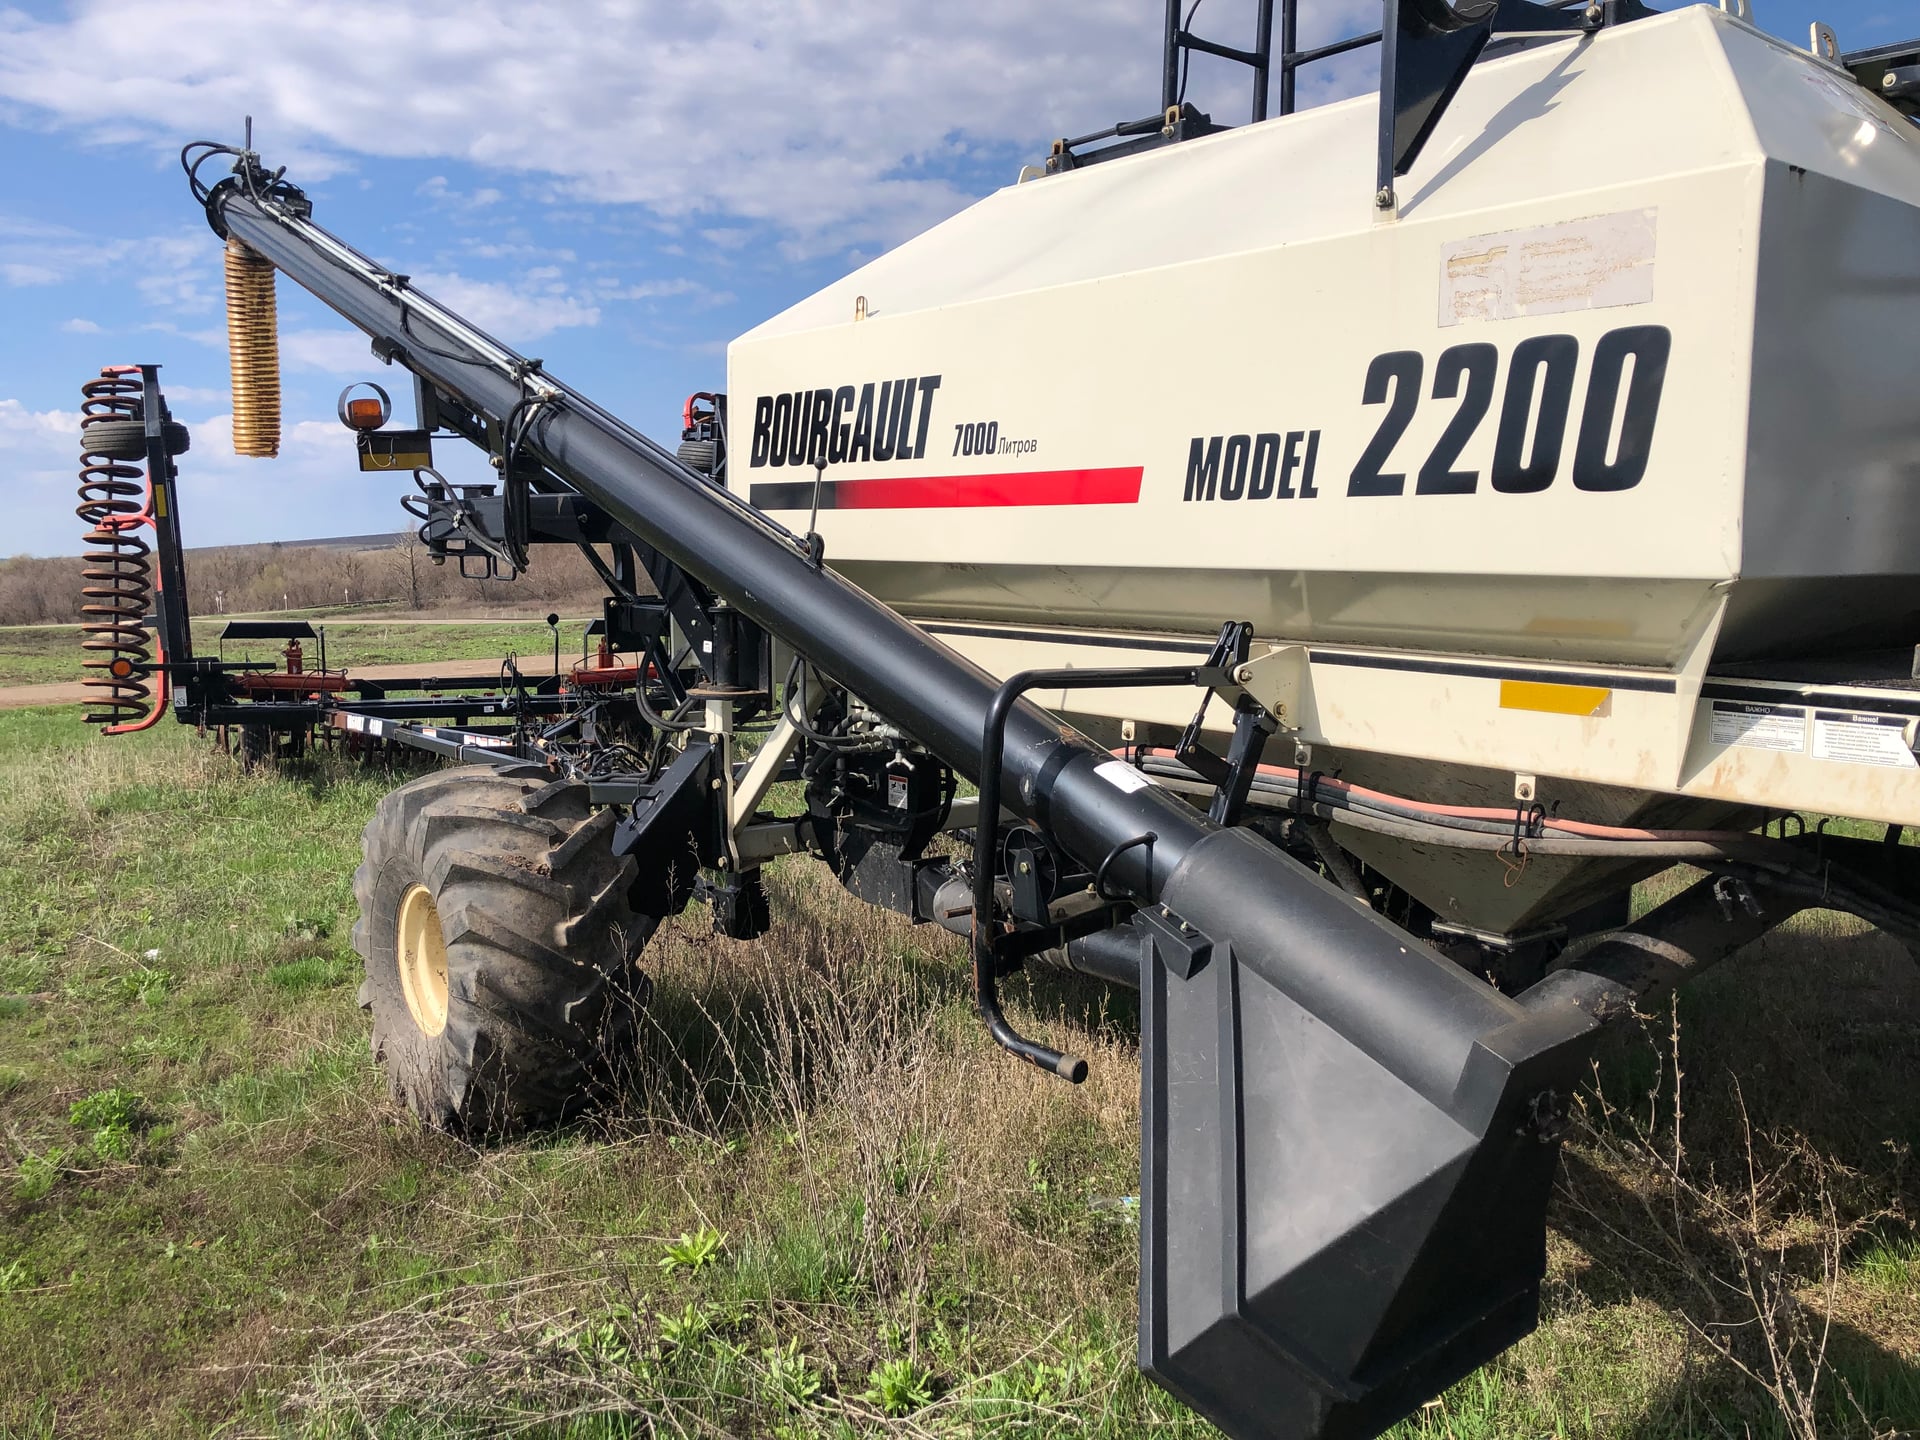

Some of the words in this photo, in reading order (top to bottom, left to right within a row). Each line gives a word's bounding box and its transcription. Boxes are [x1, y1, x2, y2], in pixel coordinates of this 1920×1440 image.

[750, 374, 942, 469] BOURGAULT
[1183, 429, 1321, 502] MODEL
[1346, 325, 1672, 498] 2200
[952, 421, 998, 458] 7000
[998, 436, 1037, 459] Литров
[1745, 705, 1771, 714] ВАЖНО
[1852, 714, 1879, 724] Важно!
